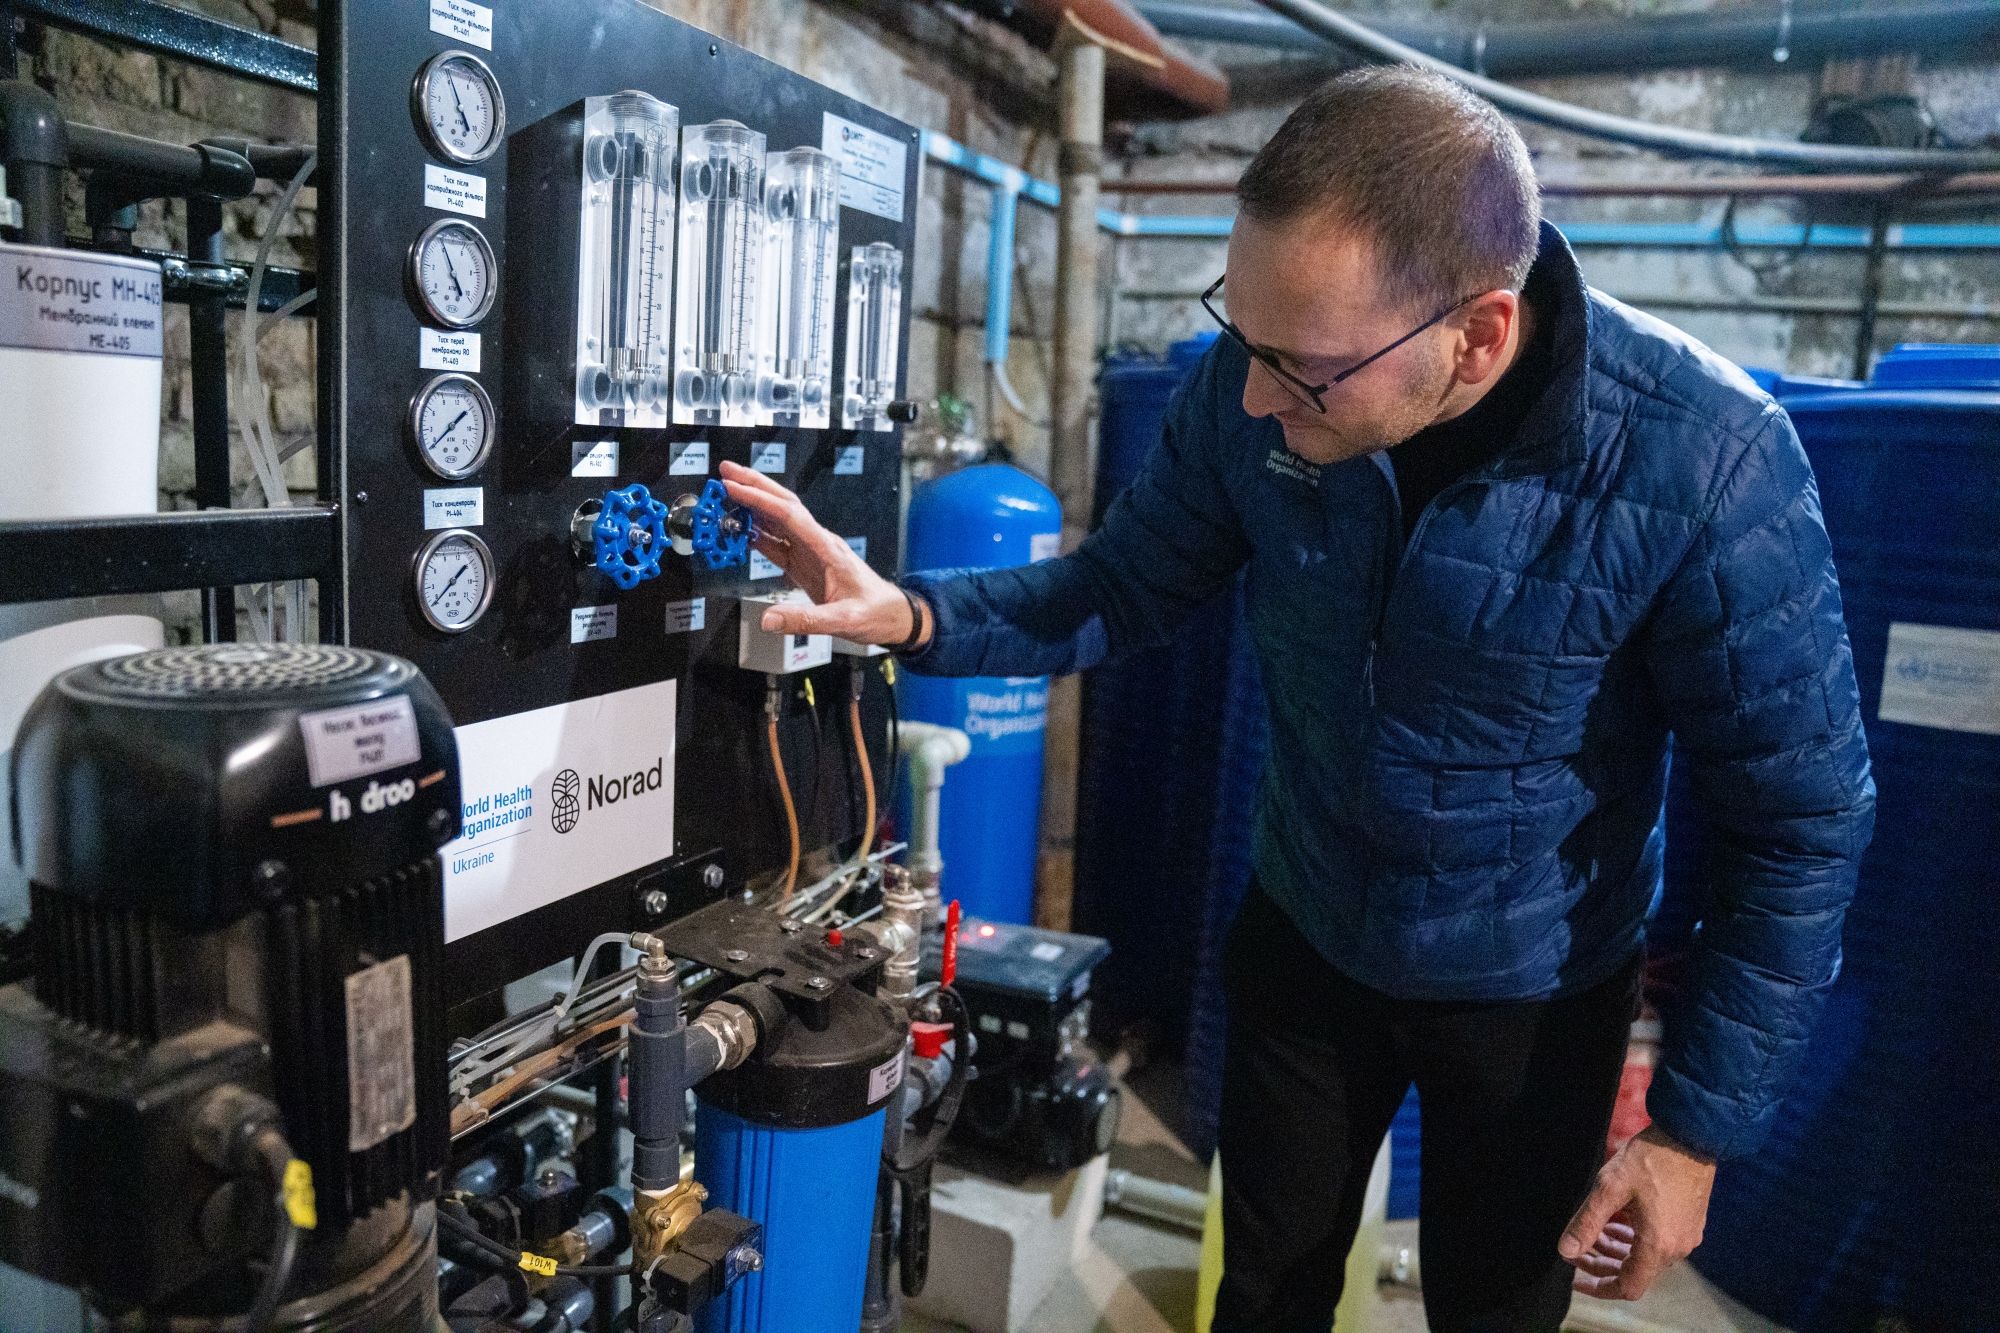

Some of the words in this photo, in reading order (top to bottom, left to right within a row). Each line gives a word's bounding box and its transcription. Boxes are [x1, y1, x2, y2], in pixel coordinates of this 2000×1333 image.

[443, 174, 455, 184] Тиск
[456, 177, 469, 187] після
[16, 266, 102, 304] Корпус
[438, 335, 450, 343] Тиск
[450, 337, 465, 346] перед
[1270, 449, 1295, 465] World
[587, 757, 663, 811] Norad
[494, 784, 533, 810] Health
[455, 804, 533, 840] rganization
[453, 852, 495, 875] Ukraine
